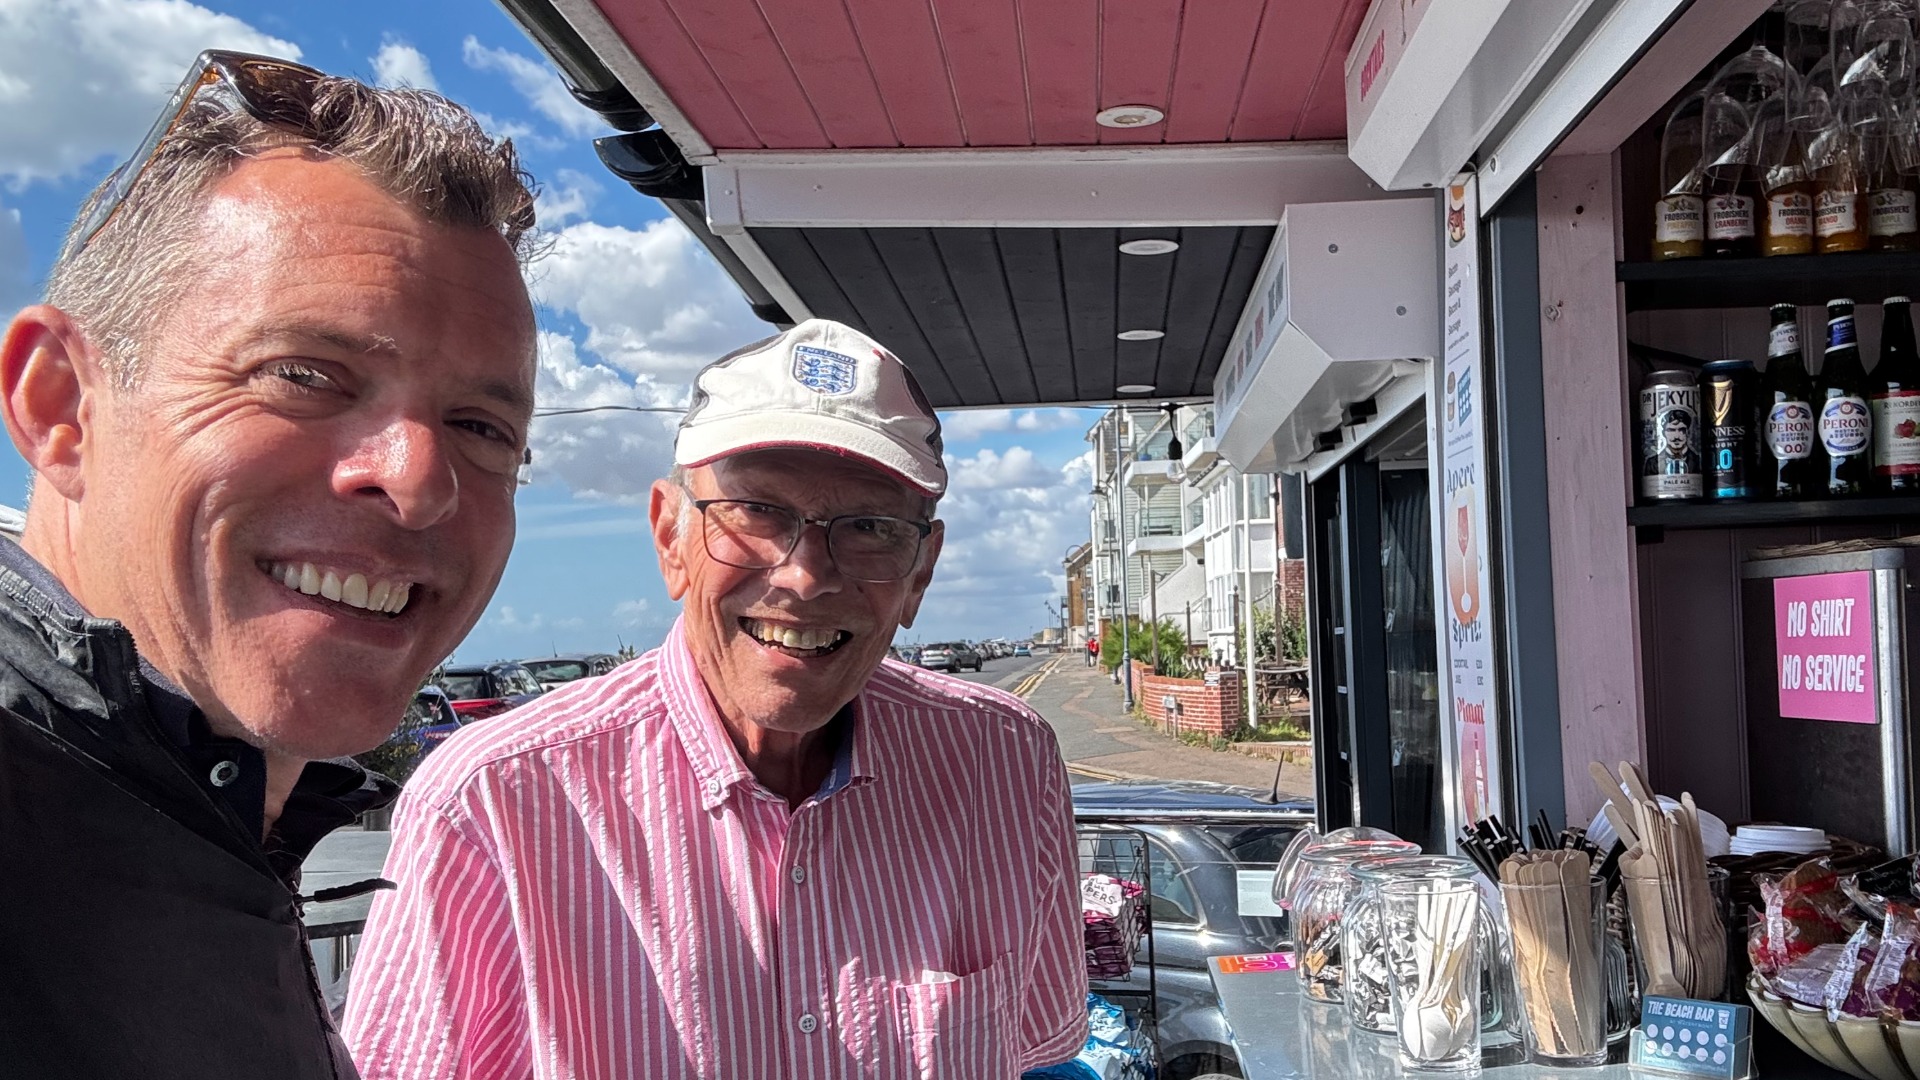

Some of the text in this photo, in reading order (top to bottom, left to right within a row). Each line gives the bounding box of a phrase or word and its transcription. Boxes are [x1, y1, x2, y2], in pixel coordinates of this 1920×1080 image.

[1713, 210, 1749, 220] FROBISHERS
[1873, 205, 1910, 216] FROBISHERS
[1664, 213, 1699, 222] FROBISHERS
[1785, 216, 1808, 225] ORANGE
[1715, 219, 1748, 228] CRANBERRY
[798, 346, 855, 363] ENGLAND
[1642, 393, 1652, 403] DR
[1769, 422, 1813, 433] PERONI
[1823, 418, 1869, 430] PERONI
[1786, 598, 1855, 638] NO SHIRT
[1781, 654, 1866, 693] NO SERVICE
[1647, 1000, 1715, 1022] THE BEACH BAR
